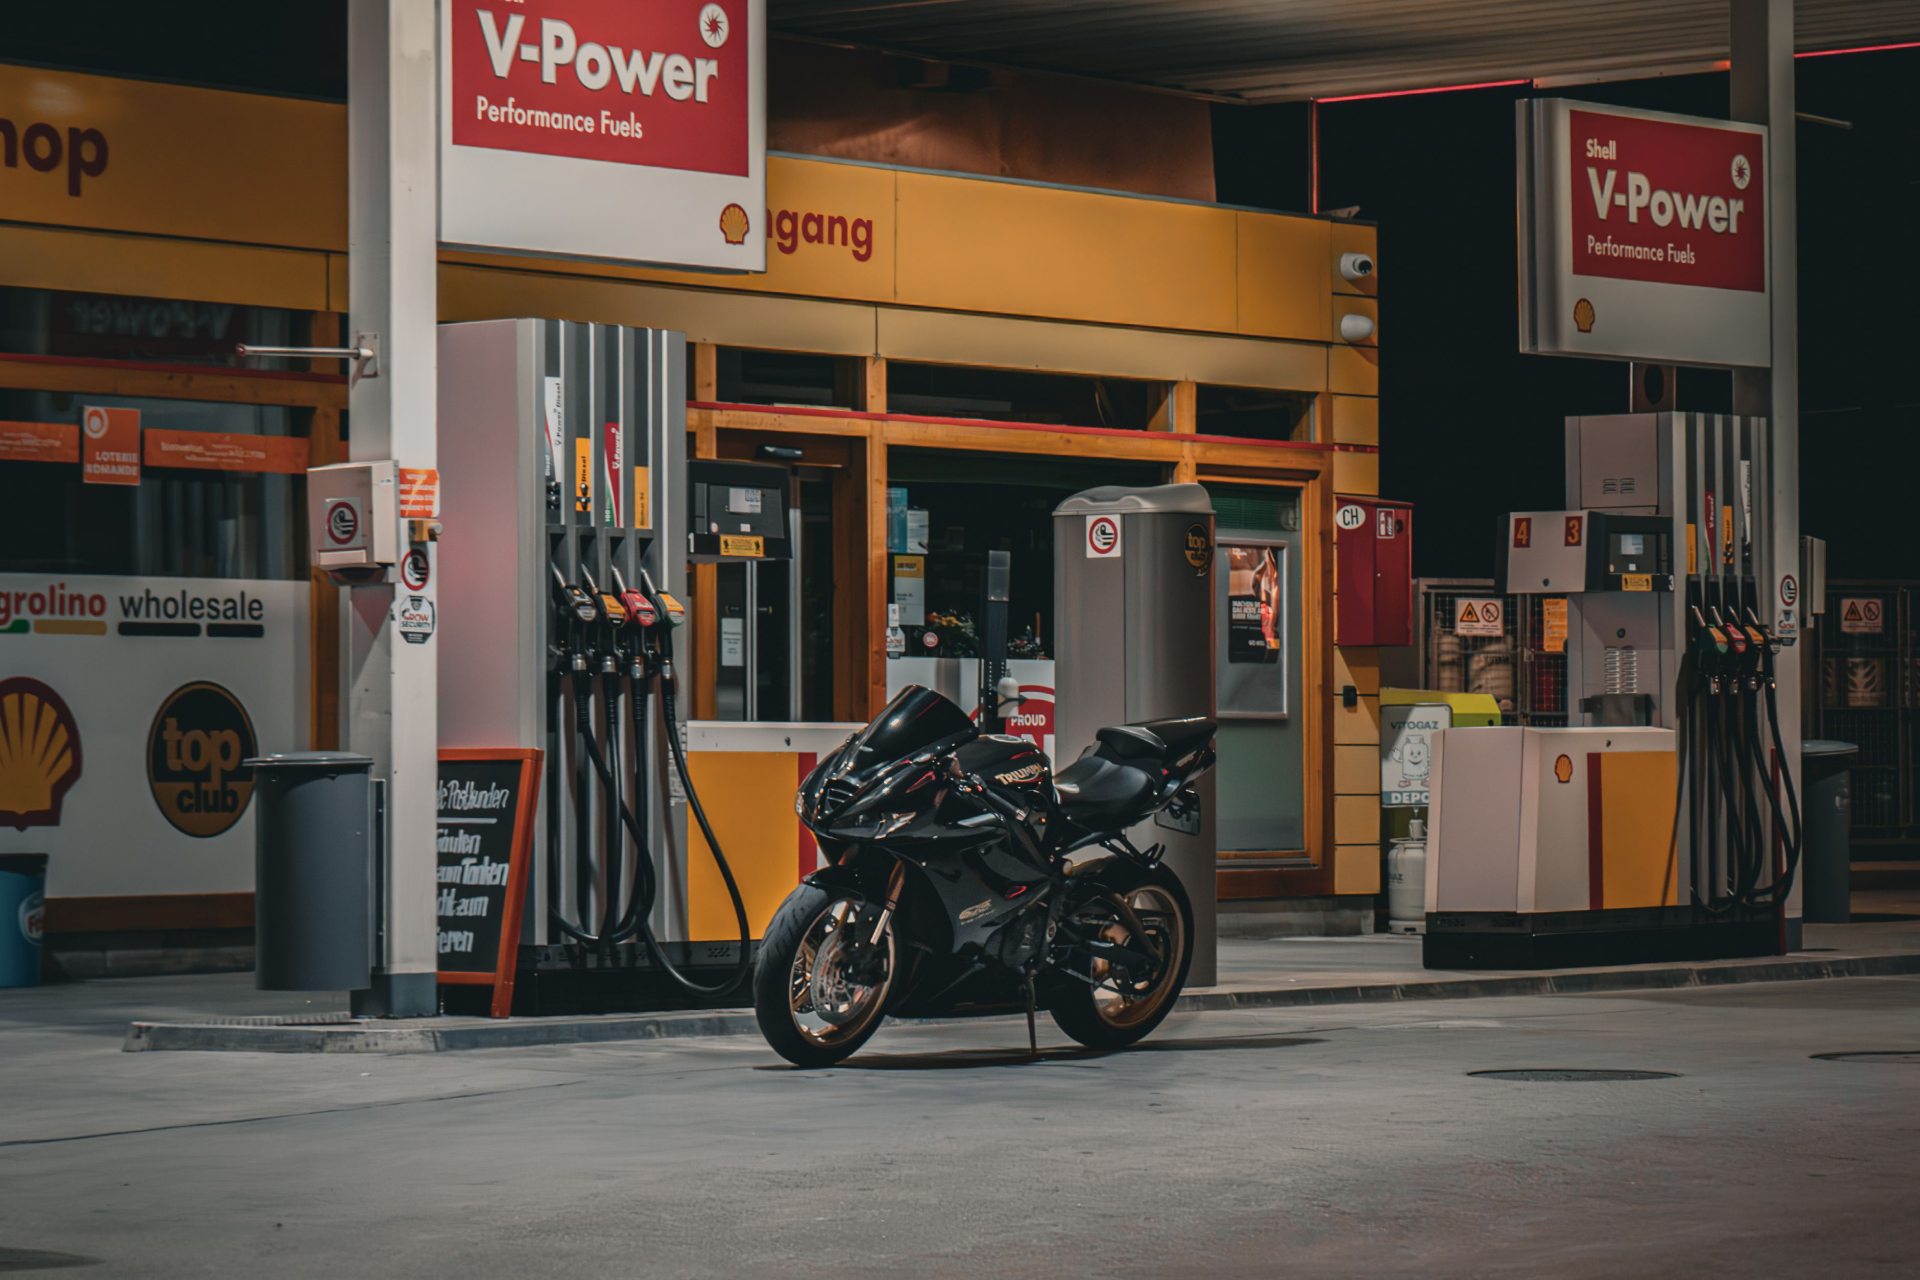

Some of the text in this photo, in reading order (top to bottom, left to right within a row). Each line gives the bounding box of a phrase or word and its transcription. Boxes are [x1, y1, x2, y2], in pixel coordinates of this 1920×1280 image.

[476, 9, 718, 103] V-Power
[476, 96, 643, 140] Performance Fuels
[1586, 138, 1617, 161] Shell
[1587, 166, 1744, 234] V-Power
[1587, 234, 1696, 265] Performance Fuels
[1342, 507, 1360, 526] CH
[688, 532, 695, 553] 1
[1516, 519, 1529, 545] 4
[1567, 519, 1580, 544] 3
[1668, 574, 1675, 591] 3
[119, 588, 264, 621] wholesale
[1010, 714, 1046, 727] PROUD
[1391, 721, 1439, 729] VITOGAZ
[163, 717, 241, 785] top
[176, 785, 240, 814] club
